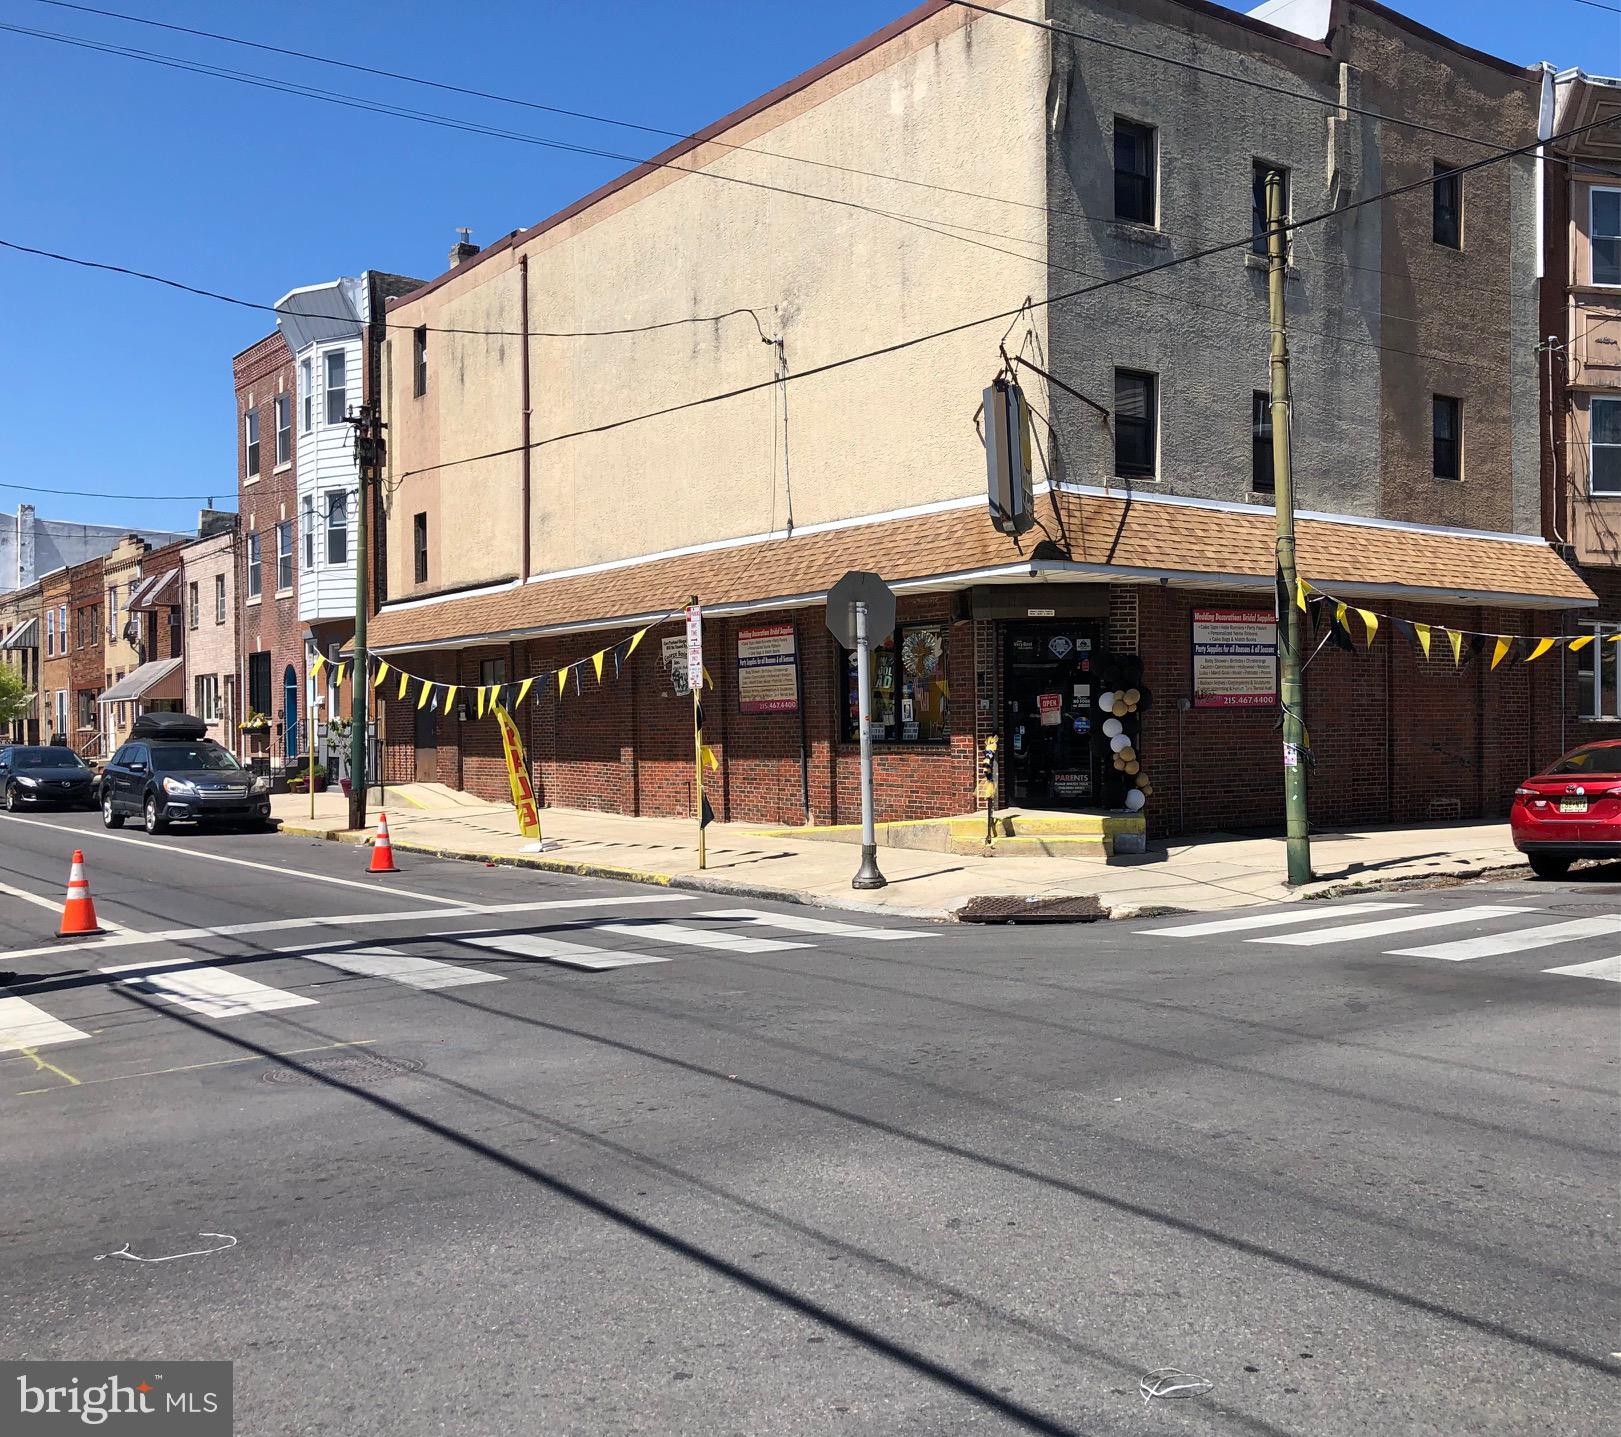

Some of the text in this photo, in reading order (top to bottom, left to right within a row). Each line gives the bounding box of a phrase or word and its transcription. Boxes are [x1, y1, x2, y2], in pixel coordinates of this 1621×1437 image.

[1194, 612, 1215, 622] Wedding
[1242, 613, 1257, 621] Bridal
[1257, 613, 1275, 623] Supplies
[1042, 699, 1057, 707] OPEN
[1223, 696, 1274, 705] 215.467.4400
[1055, 774, 1089, 782] PARENTS
